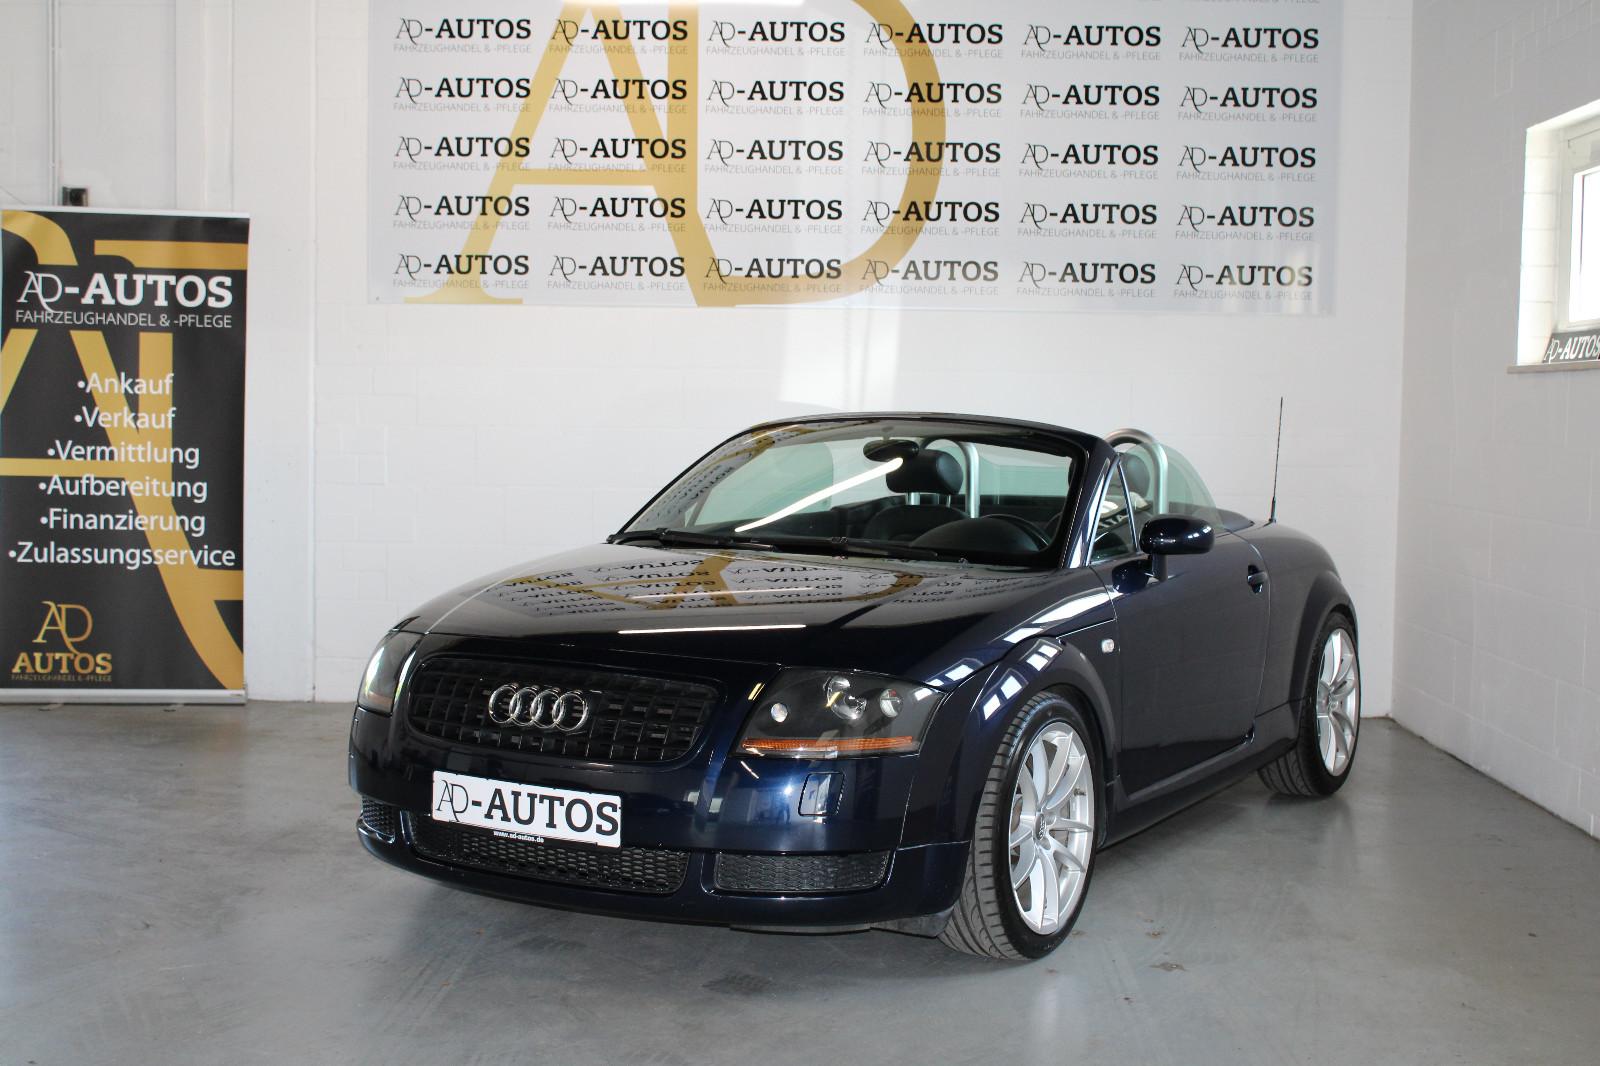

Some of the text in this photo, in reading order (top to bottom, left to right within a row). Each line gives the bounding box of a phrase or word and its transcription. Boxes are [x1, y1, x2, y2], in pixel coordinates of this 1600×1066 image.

[396, 18, 531, 46] AD-AUTOS
[551, 19, 688, 47] AD-AUTOS
[708, 20, 845, 48] AD-AUTOS
[865, 23, 1003, 50] AD-AUTOS
[1023, 25, 1161, 52] AD-AUTOS
[1182, 27, 1319, 55] AD-AUTOS
[394, 43, 480, 53] FAHRZEUGHANDEL
[706, 45, 793, 56] FAHRZEUGHANDEL
[863, 47, 951, 58] FAHRZEUGHANDEL
[1021, 49, 1109, 60] FAHRZEUGHANDEL
[1180, 52, 1268, 63] FAHRZEUGHANDEL
[395, 77, 530, 105] AD-AUTOS
[551, 78, 687, 106] AD-AUTOS
[708, 80, 844, 108] AD-AUTOS
[865, 82, 1002, 110] AD-AUTOS
[1022, 84, 1160, 111] AD-AUTOS
[1181, 86, 1317, 114] AD-AUTOS
[393, 102, 480, 112] FAHRZEUGHANDEL
[706, 105, 793, 115] FAHRZEUGHANDEL
[863, 107, 951, 118] FAHRZEUGHANDEL
[1020, 108, 1108, 119] FAHRZEUGHANDEL
[1179, 111, 1266, 122] FAHRZEUGHANDEL
[395, 136, 530, 163] AD-AUTOS
[551, 138, 687, 165] AD-AUTOS
[707, 139, 843, 167] AD-AUTOS
[864, 141, 1001, 169] AD-AUTOS
[1021, 143, 1159, 171] AD-AUTOS
[1179, 145, 1316, 174] AD-AUTOS
[393, 160, 479, 171] FAHRZEUGHANDEL
[705, 164, 792, 174] FAHRZEUGHANDEL
[862, 166, 950, 177] FAHRZEUGHANDEL
[1019, 168, 1107, 179] FAHRZEUGHANDEL
[1177, 171, 1265, 182] FAHRZEUGHANDEL
[395, 195, 530, 222] AD-AUTOS
[551, 197, 686, 224] AD-AUTOS
[707, 198, 842, 226] AD-AUTOS
[863, 201, 1000, 228] AD-AUTOS
[1020, 203, 1157, 230] AD-AUTOS
[1177, 205, 1315, 233] AD-AUTOS
[393, 219, 479, 230] FAHRZEUGHANDEL
[705, 223, 791, 234] FAHRZEUGHANDEL
[861, 225, 948, 236] FAHRZEUGHANDEL
[1018, 227, 1106, 238] FAHRZEUGHANDEL
[1175, 230, 1263, 241] FAHRZEUGHANDEL
[395, 253, 529, 281] AD-AUTOS
[550, 256, 685, 283] AD-AUTOS
[705, 257, 842, 285] AD-AUTOS
[861, 260, 999, 287] AD-AUTOS
[1018, 262, 1156, 290] AD-AUTOS
[1175, 264, 1312, 293] AD-AUTOS
[16, 270, 233, 313] AD-AUTOS
[393, 278, 478, 289] FAHRZEUGHANDEL
[1016, 287, 1104, 298] FAHRZEUGHANDEL
[15, 310, 232, 329] FAHRZEUGHANDEL & -PFLEGE
[11, 652, 112, 674] AUTOS
[436, 779, 618, 836] AD-AUTOS
